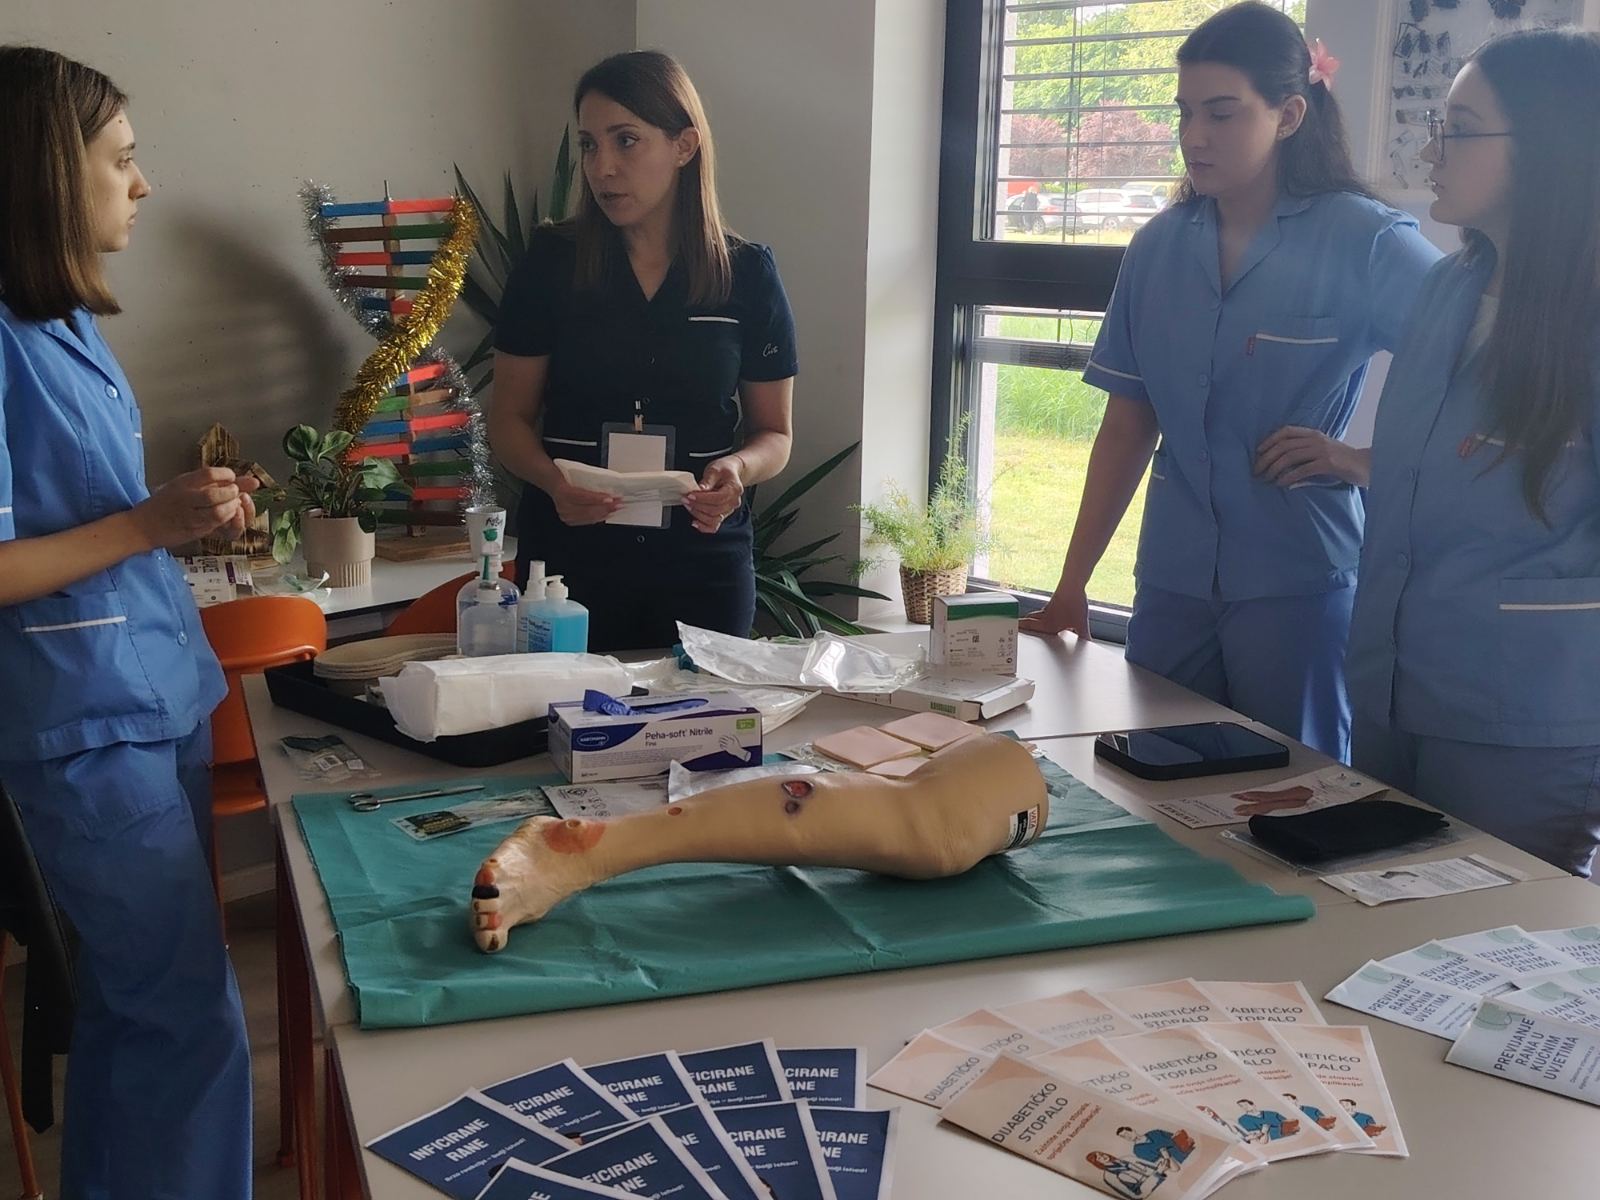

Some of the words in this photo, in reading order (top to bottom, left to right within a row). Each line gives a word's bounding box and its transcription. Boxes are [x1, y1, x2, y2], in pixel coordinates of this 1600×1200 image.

[690, 728, 713, 736] Nitrile
[1475, 944, 1538, 958] EVIJANJE
[1417, 956, 1469, 978] EVIJANJE
[1368, 977, 1415, 1012] PREVIJANJE
[1389, 993, 1417, 1011] RANA
[1408, 987, 1421, 995] U
[1228, 1006, 1303, 1014] ABETIČKO
[1412, 994, 1453, 1023] UVJETIMA
[1493, 1017, 1536, 1072] PREVIJANJE
[1515, 1040, 1541, 1067] RANA
[1531, 1031, 1545, 1040] U
[1142, 1051, 1218, 1072] JABETIČKO
[1307, 1062, 1351, 1072] PALO
[1543, 1036, 1579, 1080] UVJETIMA
[607, 1075, 663, 1092] CIRANE
[689, 1065, 756, 1081] FICIRANE
[785, 1068, 840, 1078] CIRANE
[924, 1056, 980, 1101] DIJABETIČKO
[618, 1091, 648, 1104] ANE
[788, 1081, 816, 1091] ANE
[508, 1085, 574, 1112] FICIRANE
[991, 1082, 1058, 1144] DIJABETIČKO
[1018, 1097, 1069, 1143] STOPALO
[408, 1118, 490, 1162] INFICIRANE
[728, 1127, 787, 1142] CIRANE
[445, 1138, 490, 1163] RANE
[743, 1145, 767, 1157] NE
[582, 1152, 659, 1184] FICIRANE
